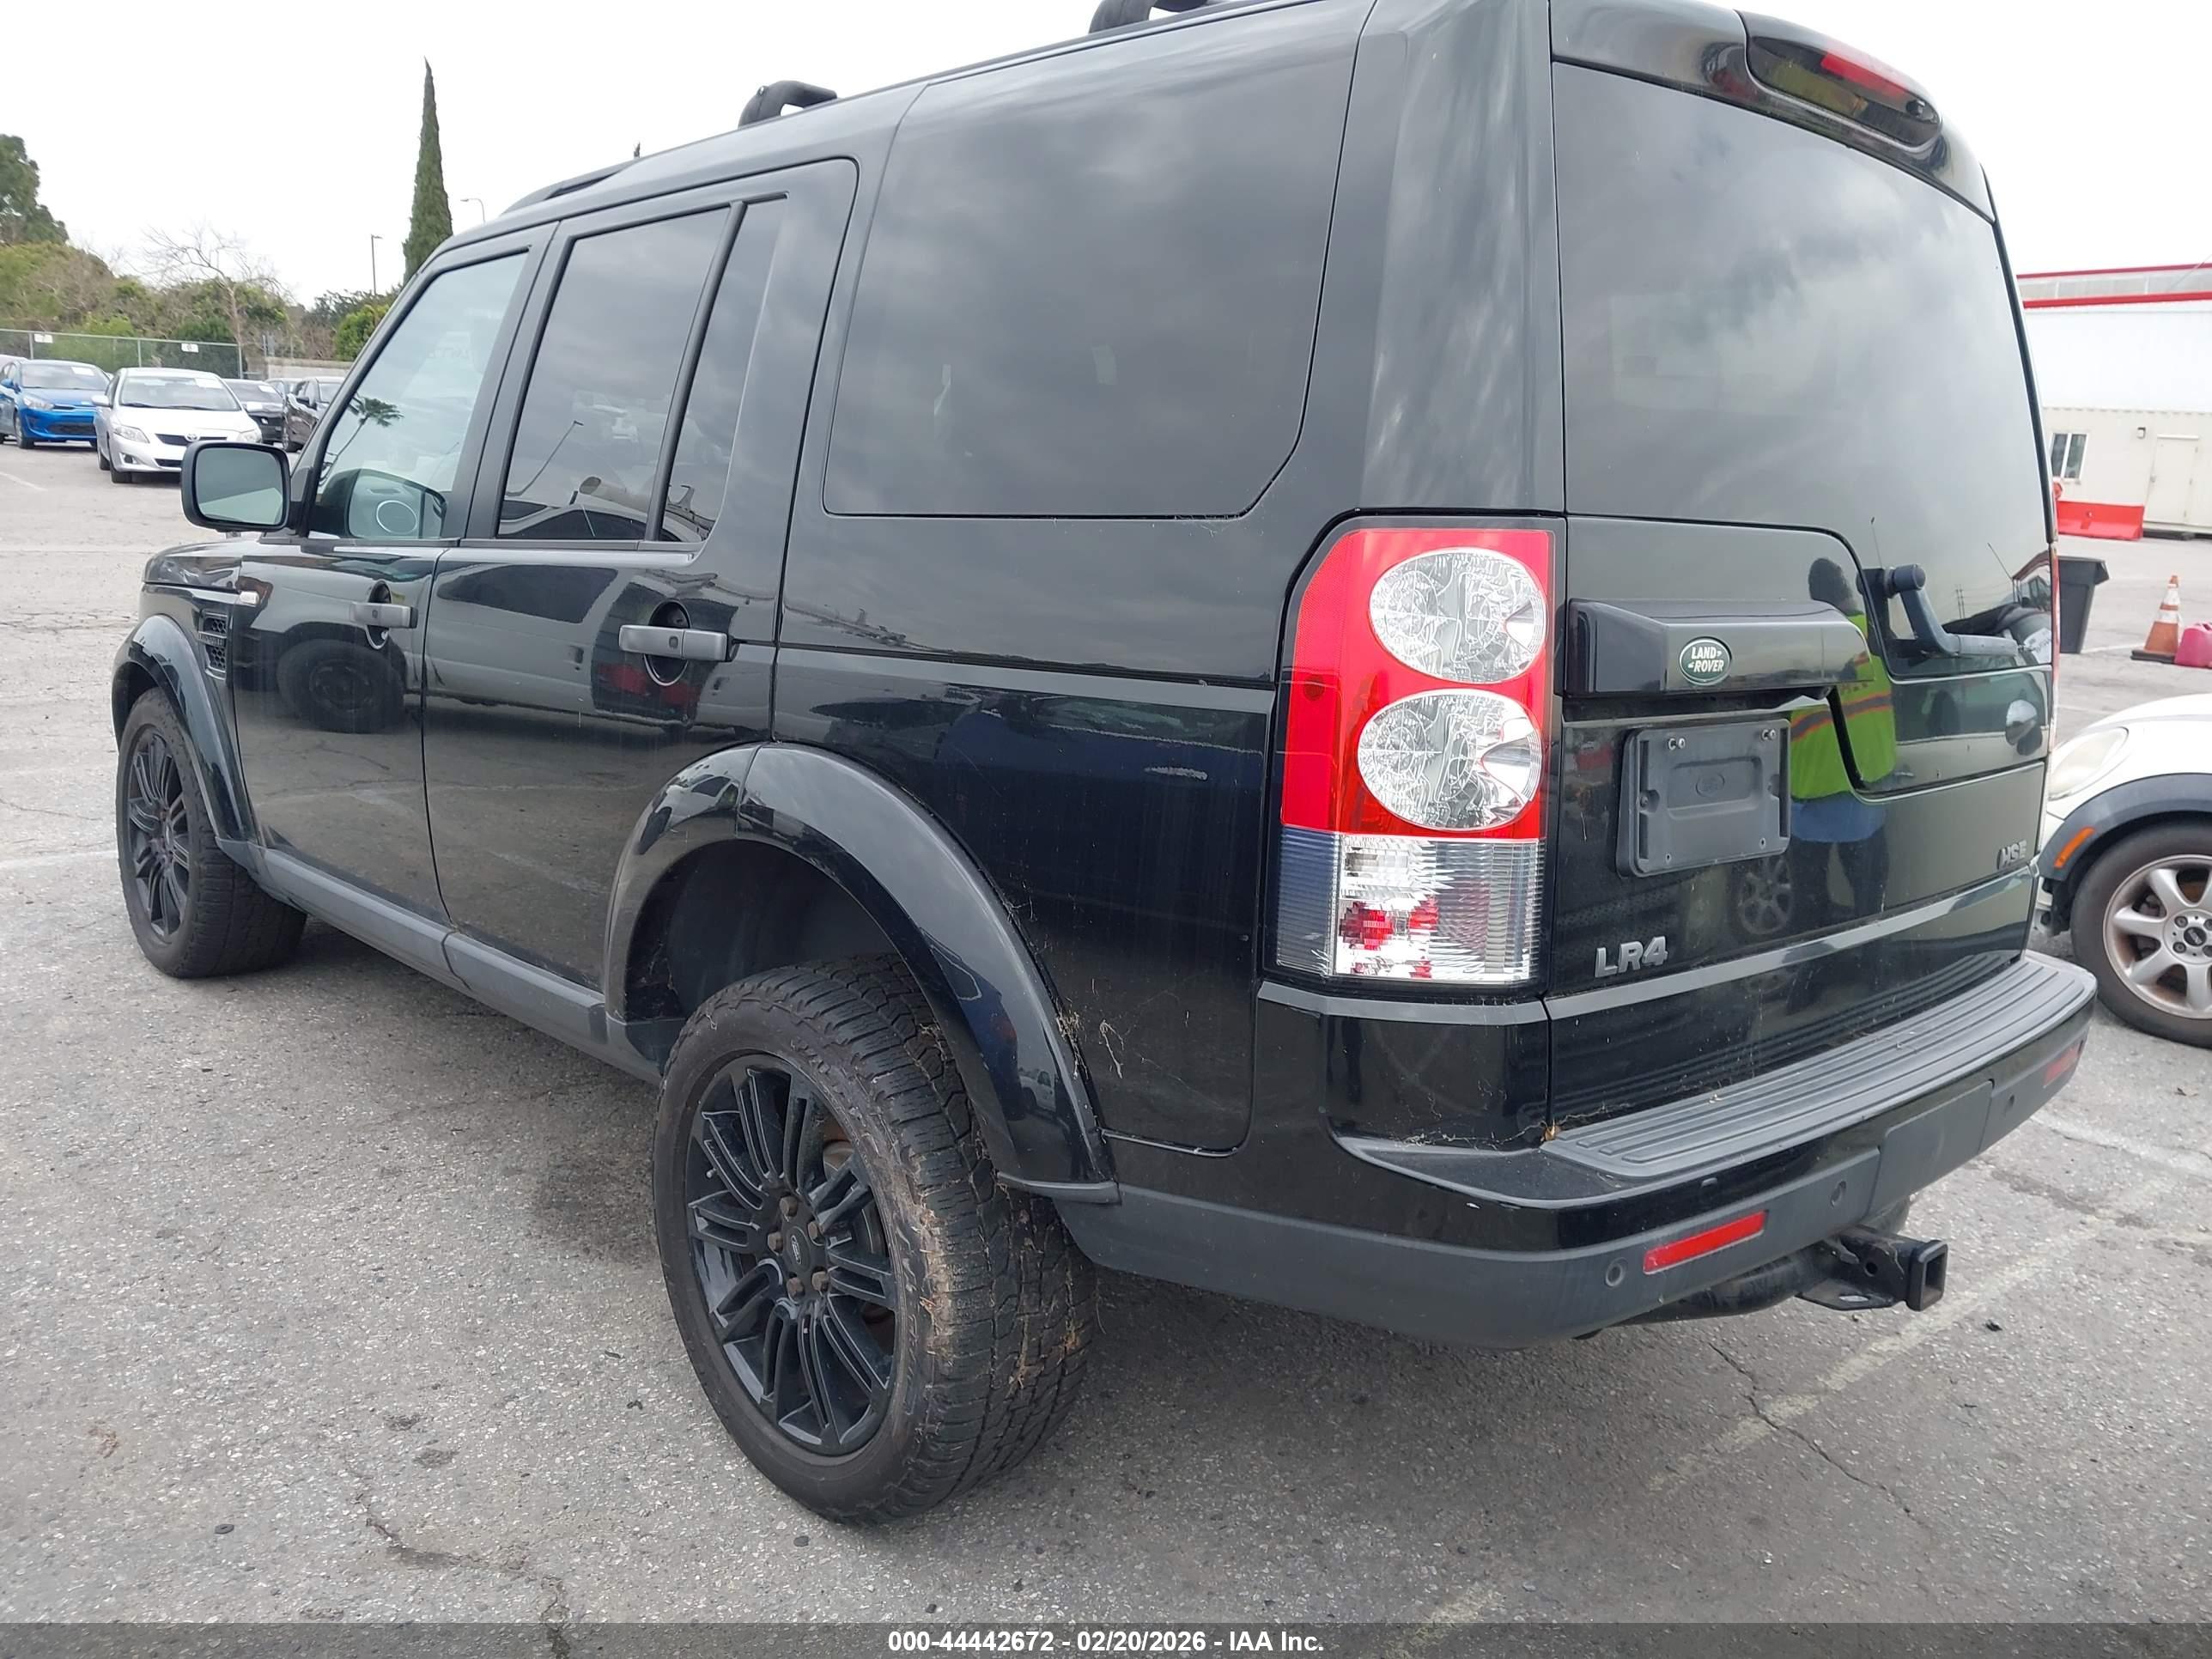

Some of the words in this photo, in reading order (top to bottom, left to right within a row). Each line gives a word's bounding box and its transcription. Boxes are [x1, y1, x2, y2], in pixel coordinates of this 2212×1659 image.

[1691, 647, 1717, 659] LAND
[1693, 659, 1724, 672] ROVER
[2000, 839, 2027, 866] HSE
[1595, 935, 1668, 978] LR4
